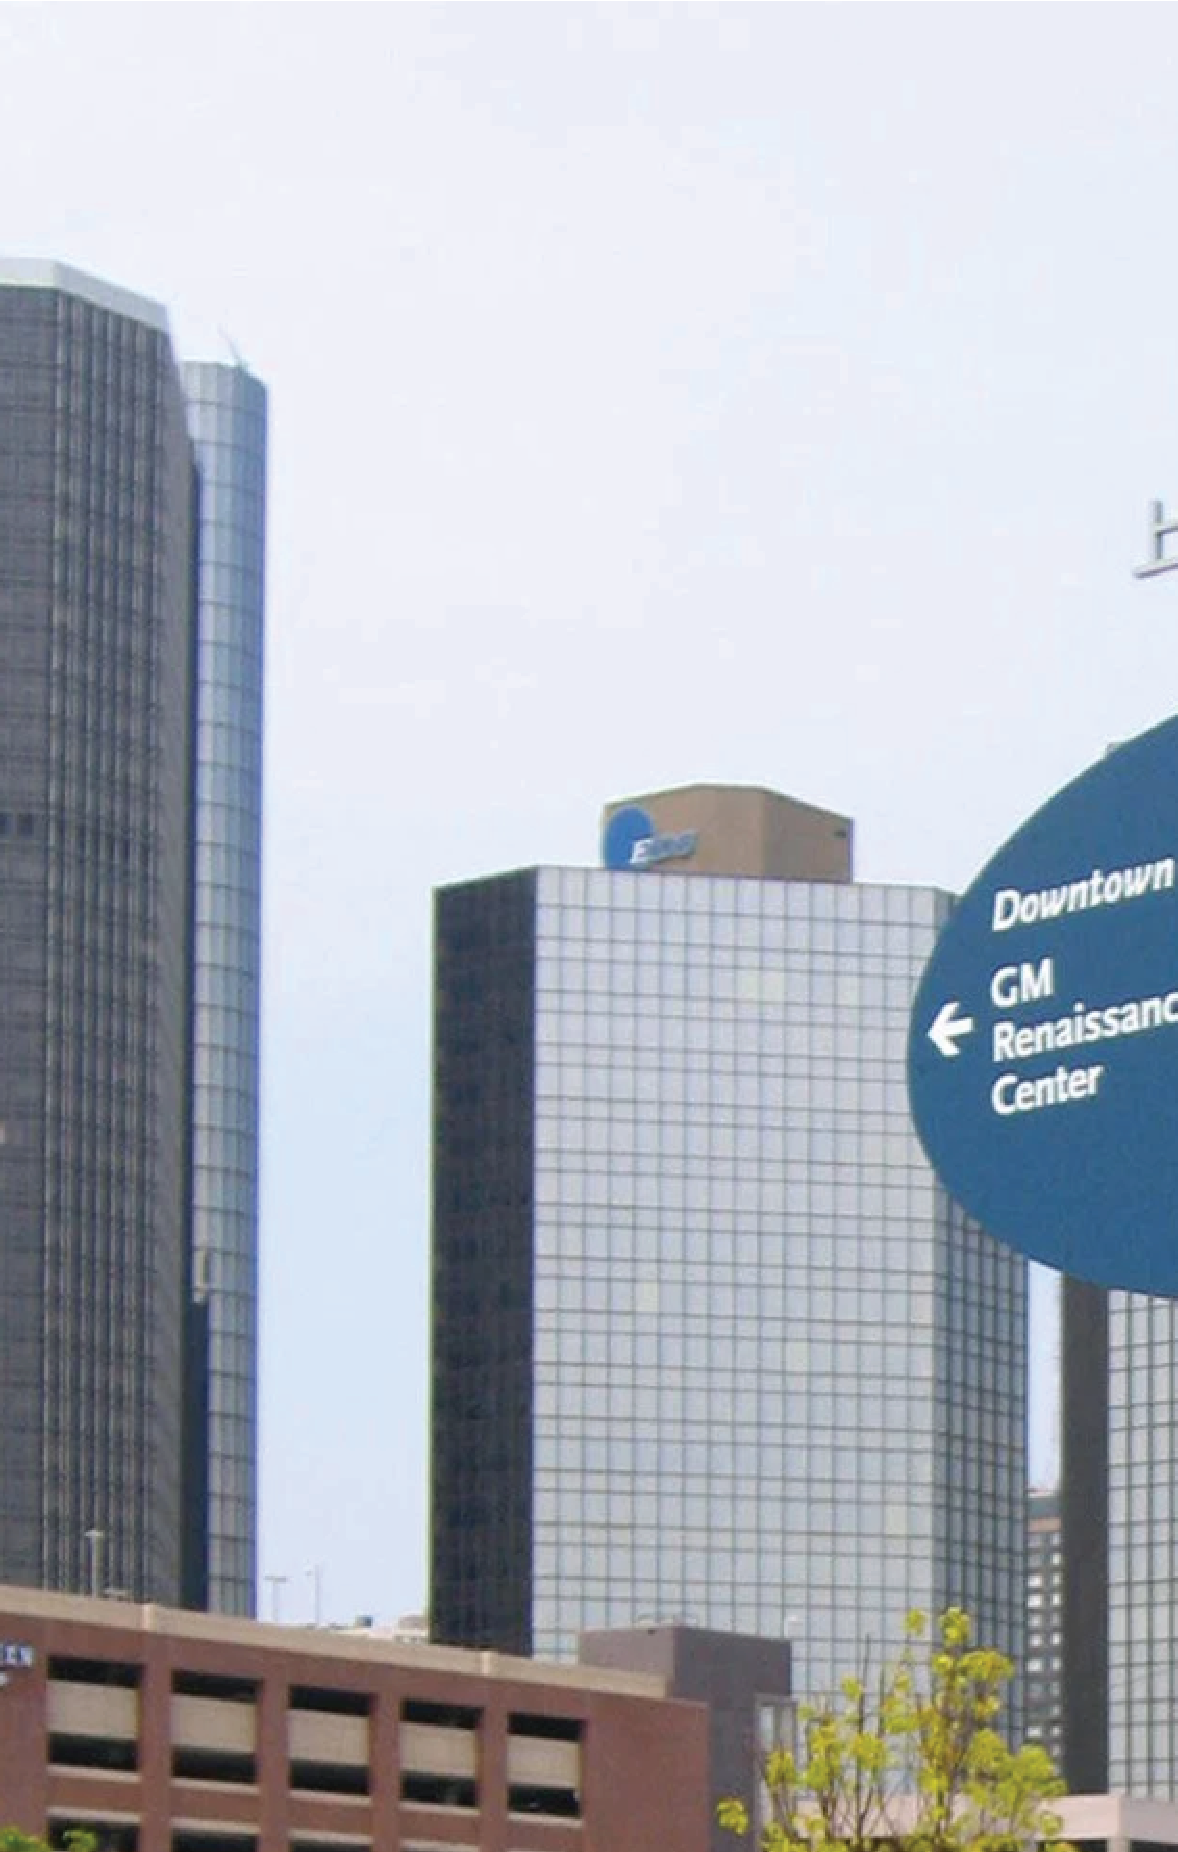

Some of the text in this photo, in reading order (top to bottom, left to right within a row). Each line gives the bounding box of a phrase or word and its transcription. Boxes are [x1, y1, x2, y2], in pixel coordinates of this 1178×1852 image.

[992, 857, 1176, 931] Downtown
[990, 957, 1054, 1007] GM
[991, 1064, 1104, 1115] Center
